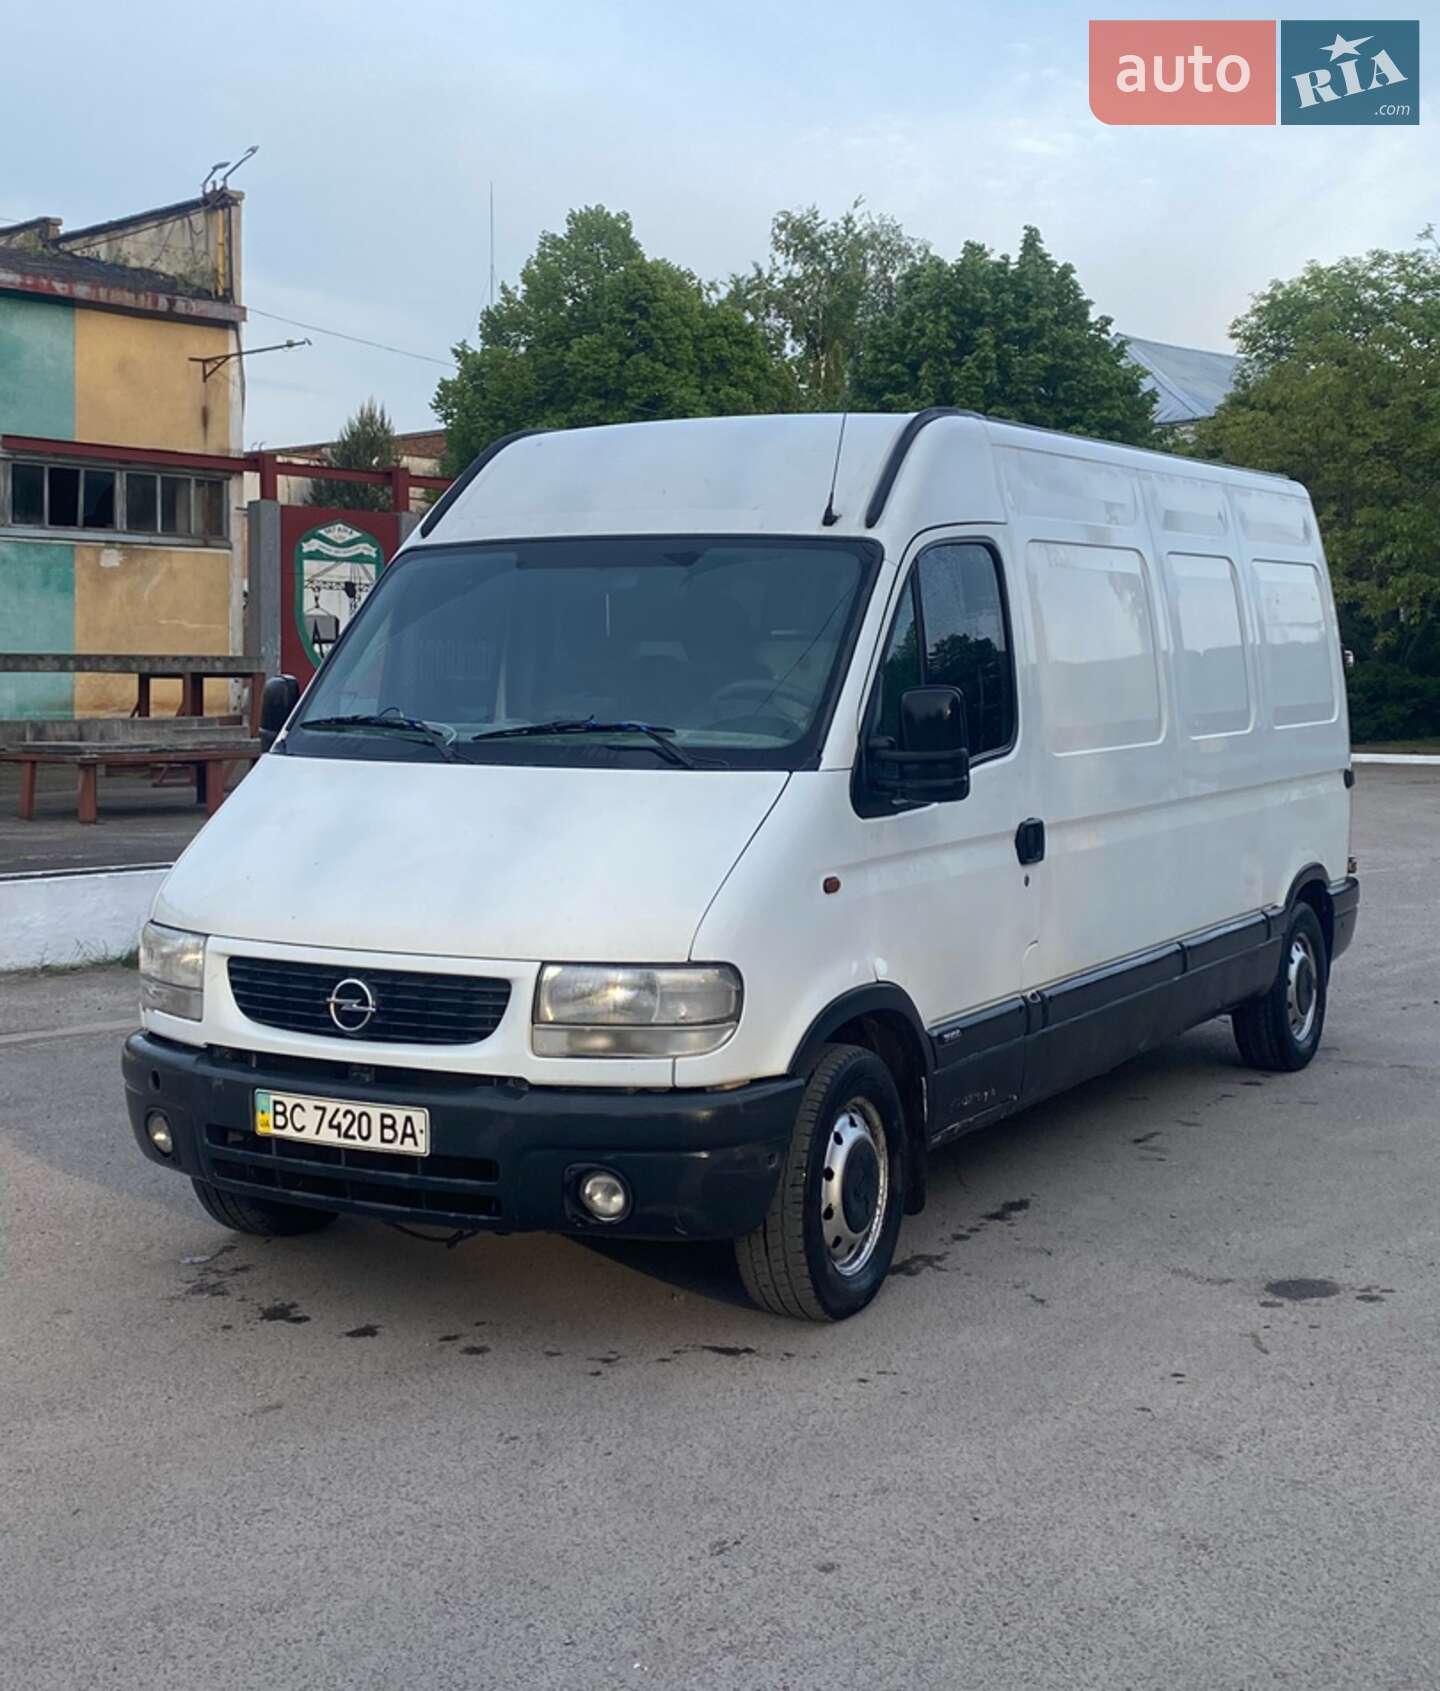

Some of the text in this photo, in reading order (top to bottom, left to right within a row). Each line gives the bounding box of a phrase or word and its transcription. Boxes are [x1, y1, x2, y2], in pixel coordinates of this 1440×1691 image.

[273, 1100, 418, 1147] BC 7420 BA
